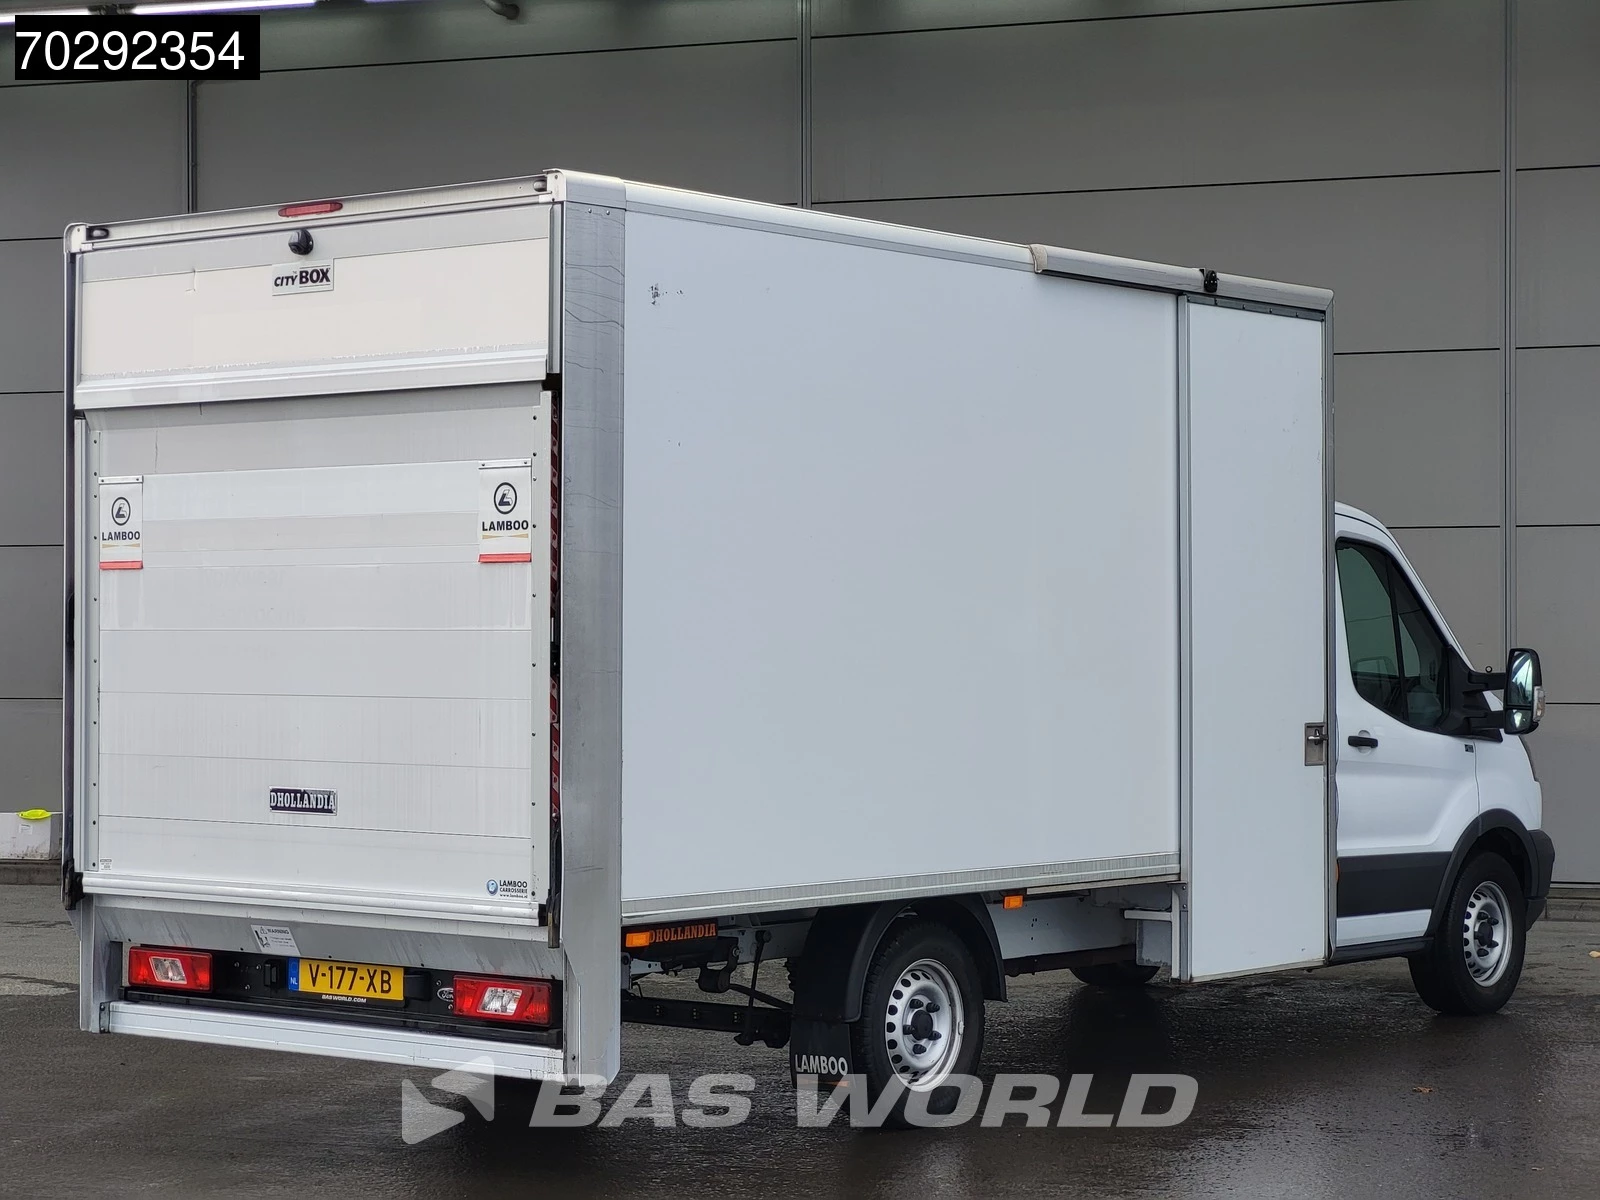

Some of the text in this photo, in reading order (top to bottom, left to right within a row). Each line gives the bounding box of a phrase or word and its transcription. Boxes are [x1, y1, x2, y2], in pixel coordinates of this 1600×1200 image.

[274, 268, 331, 287] CITY BOX
[482, 520, 529, 532] LAMBOO
[101, 531, 141, 541] LAMBOO
[270, 792, 335, 809] DHOLLANDIA
[500, 880, 528, 888] LAMBOO
[649, 923, 717, 943] DHOLLANDIA
[290, 977, 298, 985] NL
[309, 963, 392, 994] V-177-XB
[795, 1054, 849, 1075] LAMBOO
